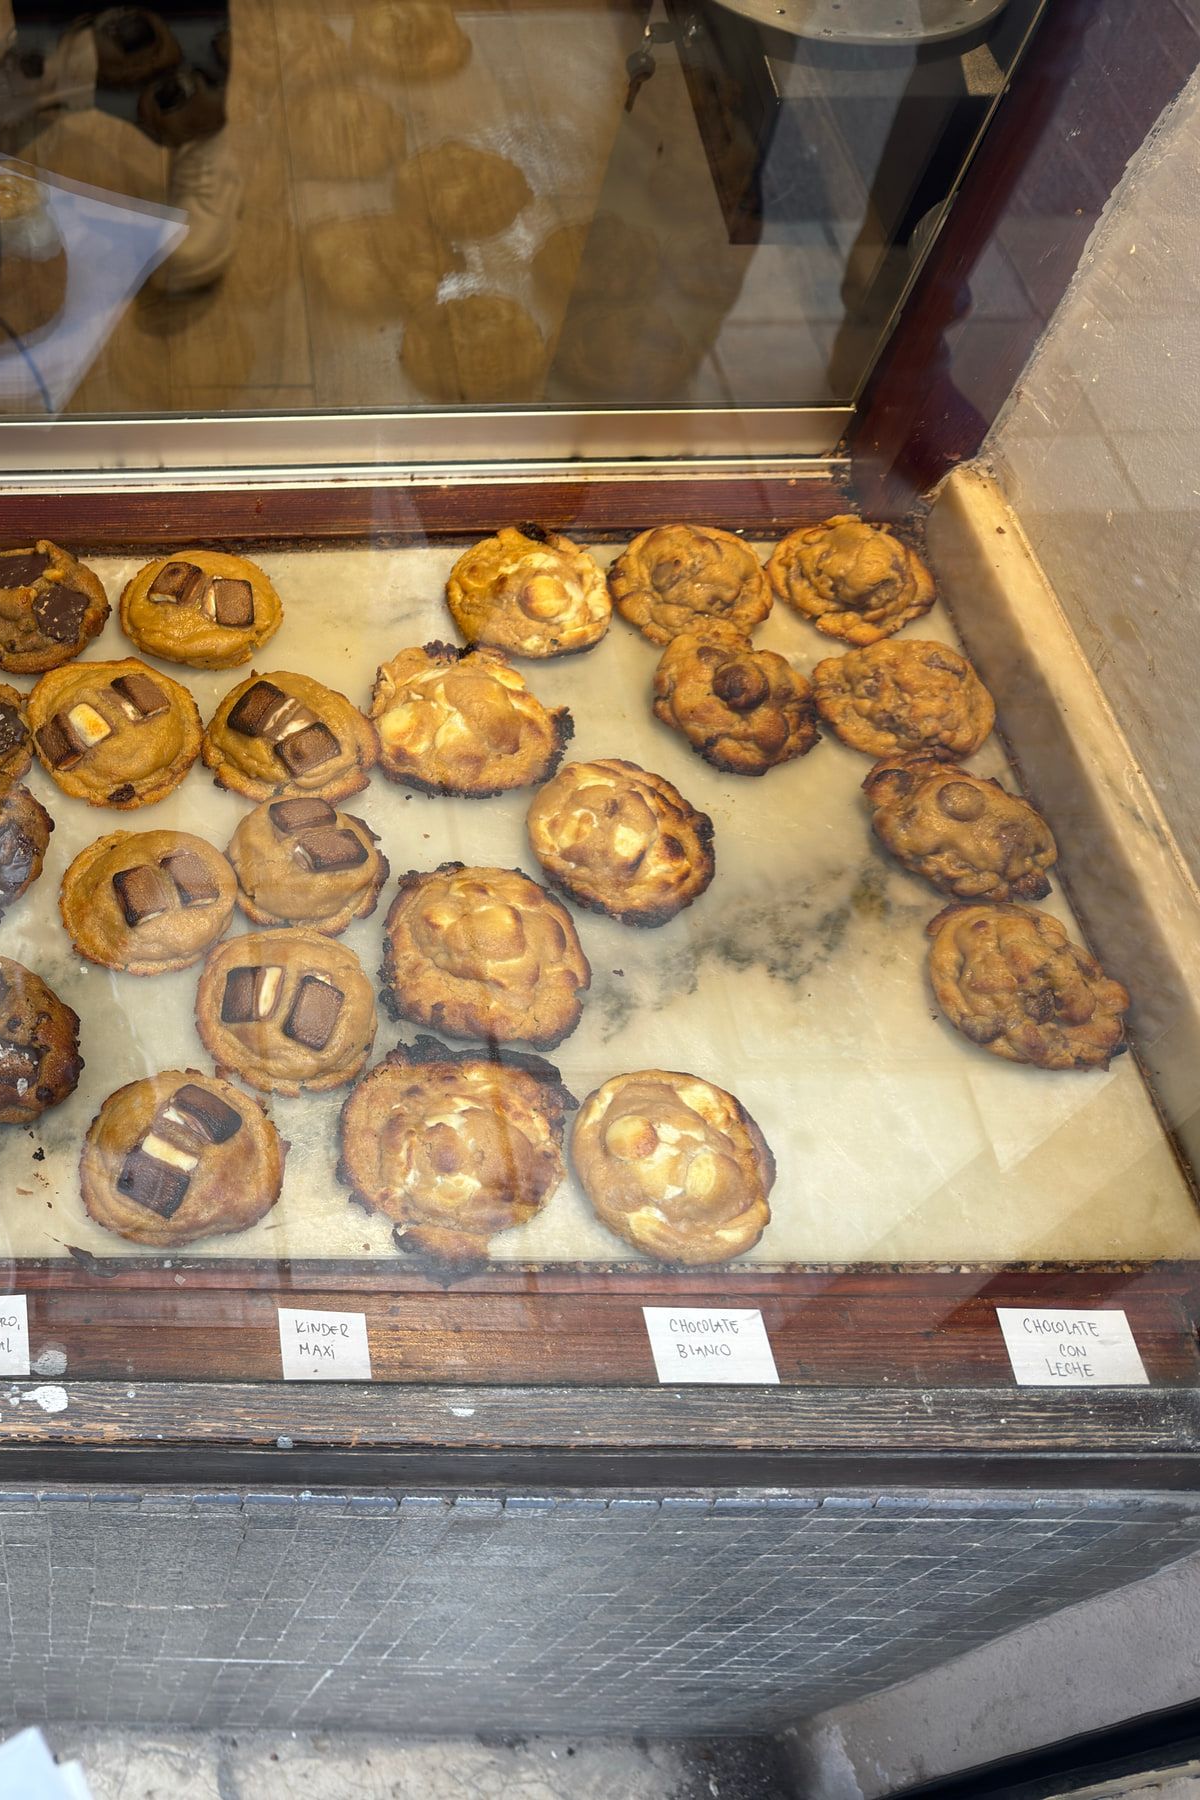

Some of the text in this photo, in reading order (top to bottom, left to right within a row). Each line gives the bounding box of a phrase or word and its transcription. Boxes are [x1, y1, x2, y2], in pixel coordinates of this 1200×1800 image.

[669, 1318, 739, 1334] CHOCOLATE
[1022, 1317, 1100, 1337] CHOCOLATE
[676, 1343, 732, 1359] BLANCO
[1059, 1343, 1087, 1357] CON
[1045, 1358, 1094, 1378] LECHE
